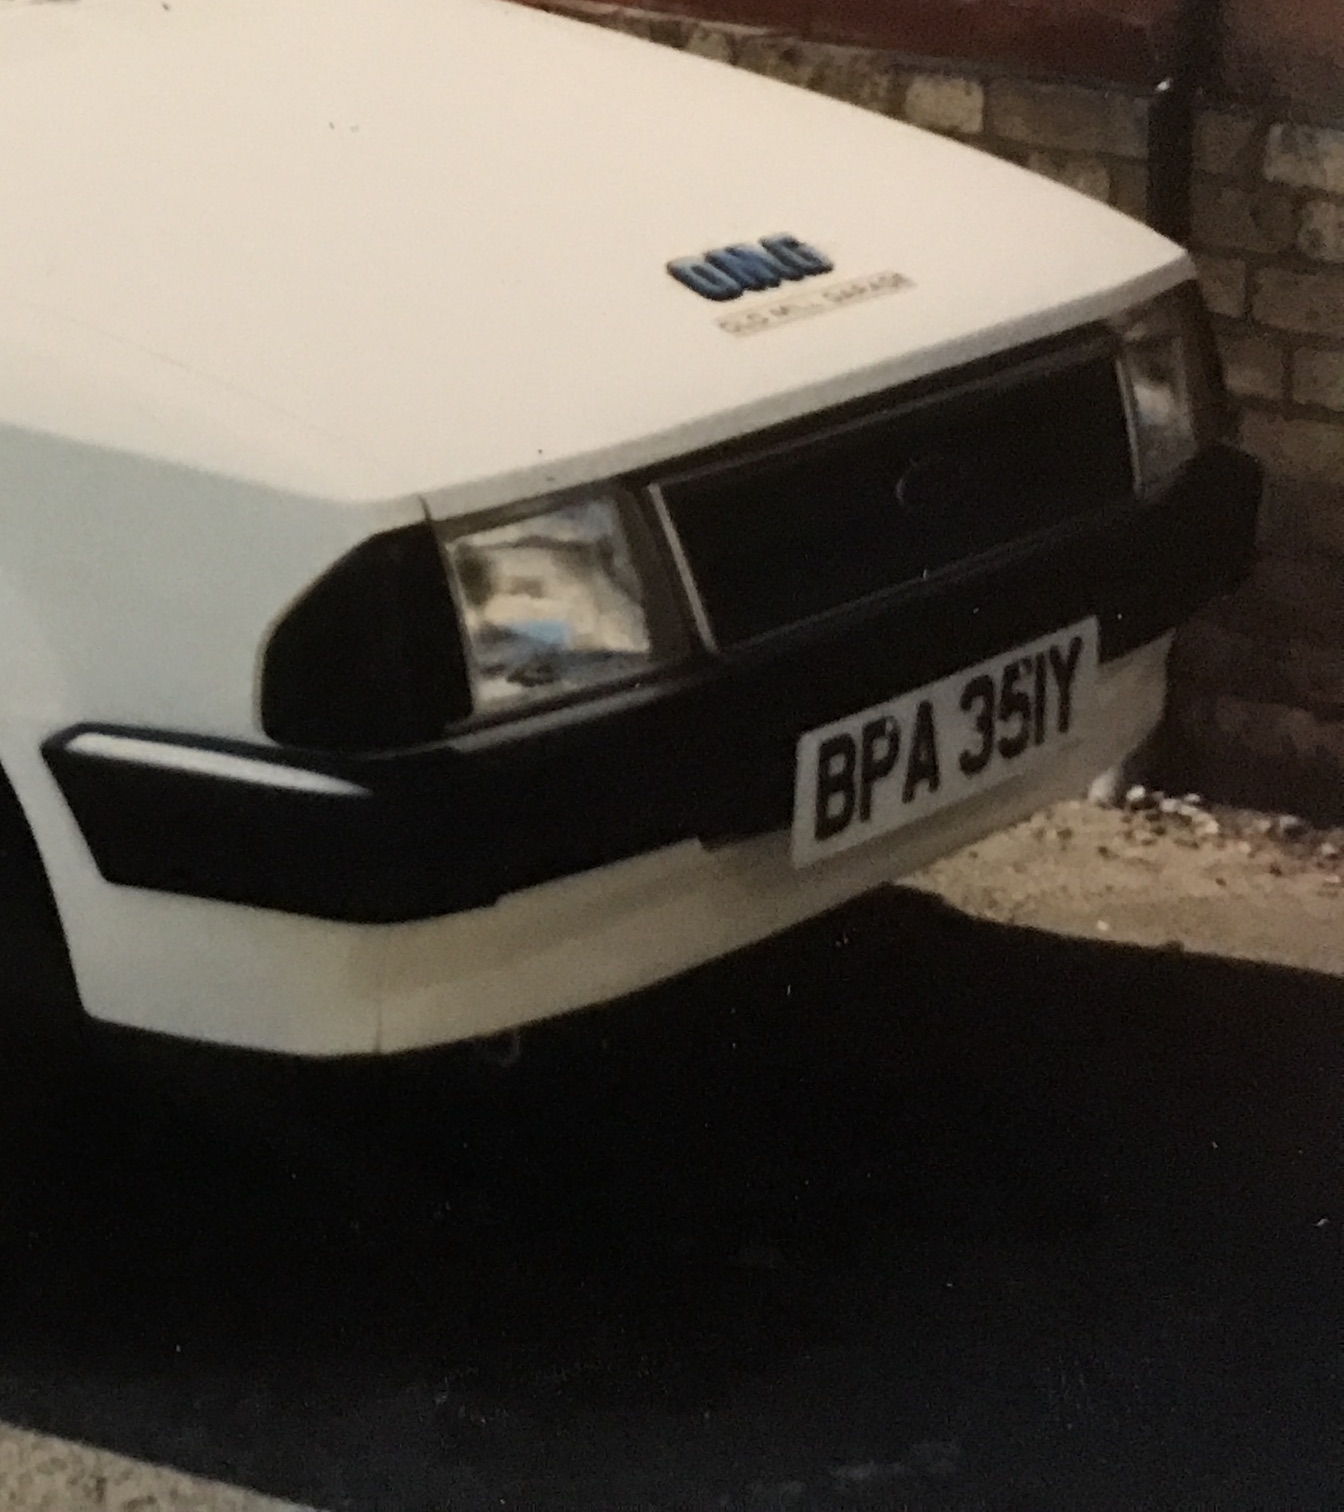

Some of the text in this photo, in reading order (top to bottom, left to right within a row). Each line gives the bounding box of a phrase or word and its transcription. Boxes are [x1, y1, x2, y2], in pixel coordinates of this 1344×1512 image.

[666, 232, 834, 302] OMG
[815, 635, 1084, 842] BPA 351Y
